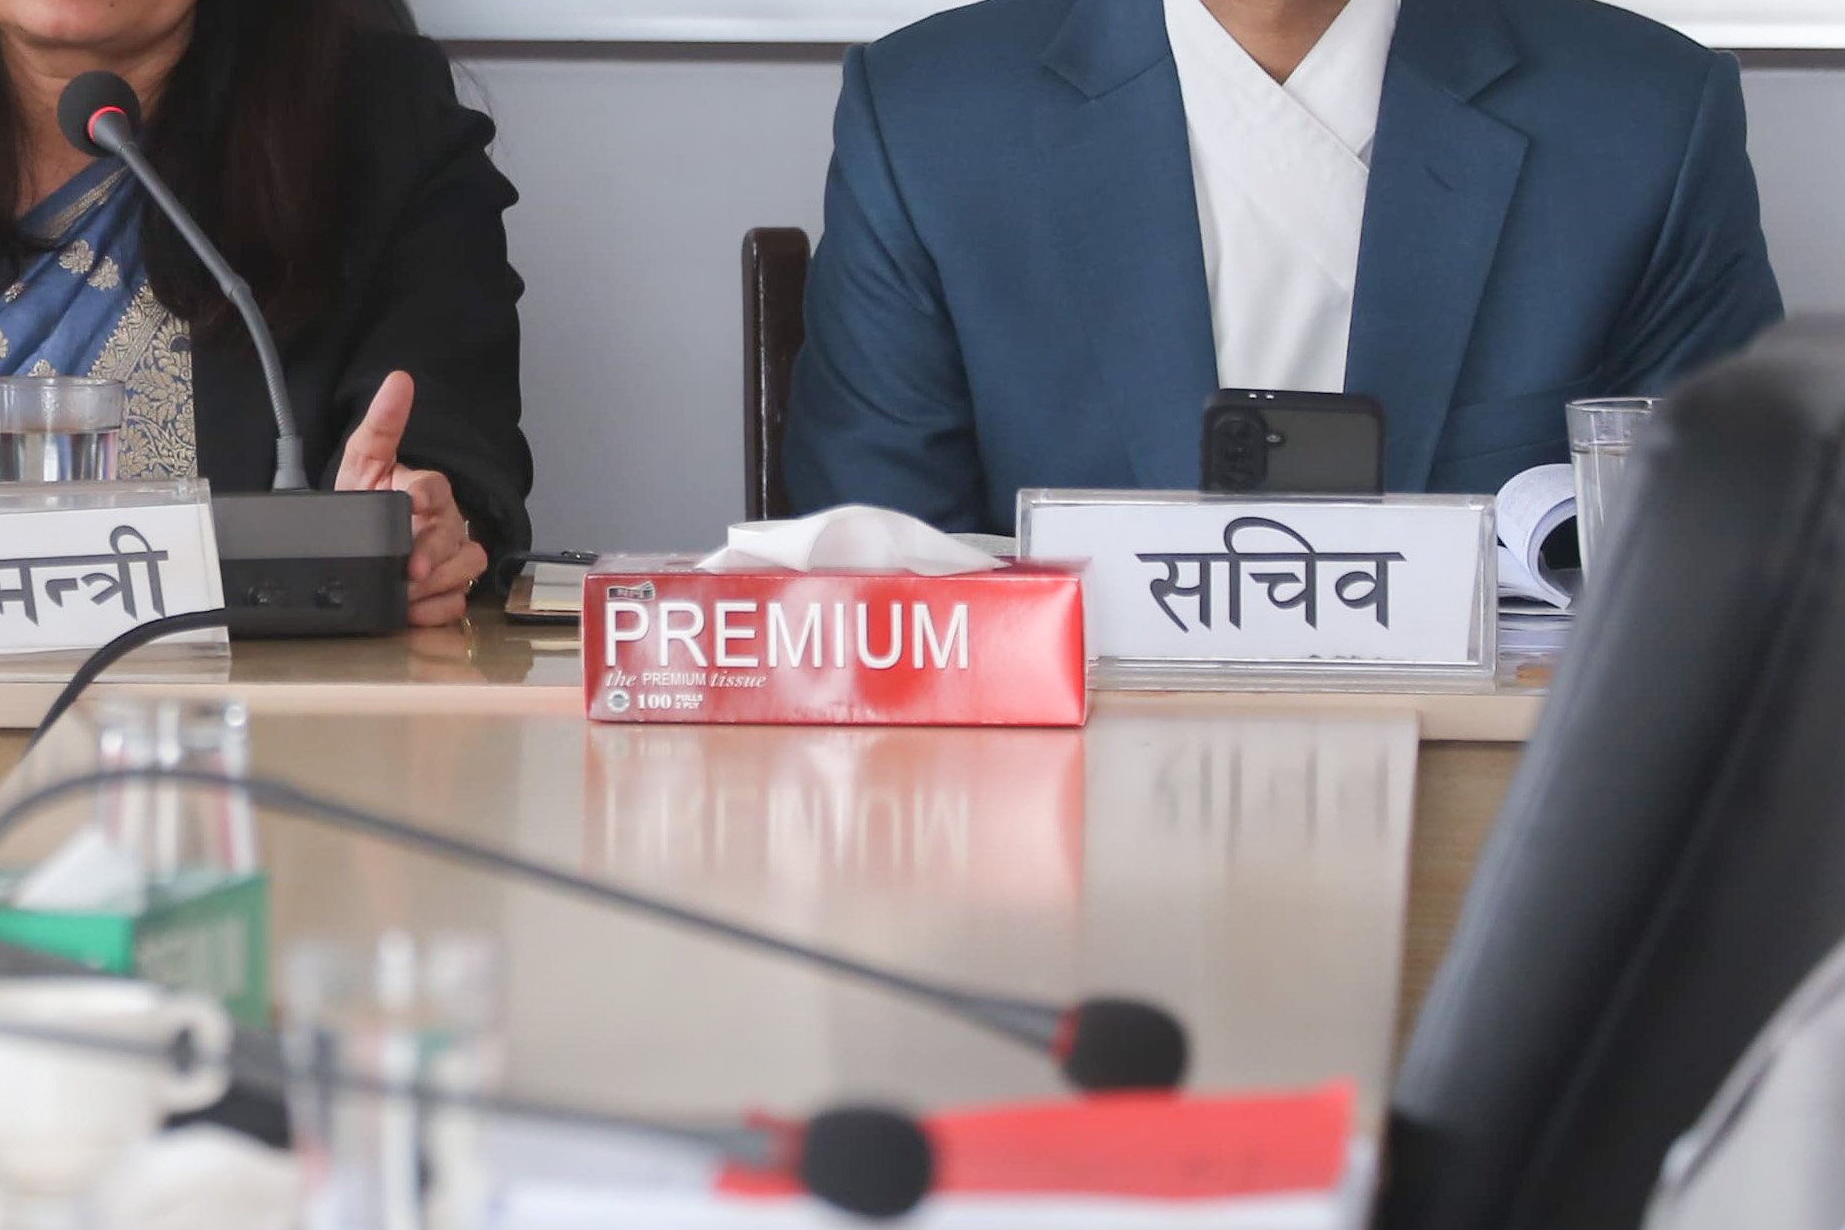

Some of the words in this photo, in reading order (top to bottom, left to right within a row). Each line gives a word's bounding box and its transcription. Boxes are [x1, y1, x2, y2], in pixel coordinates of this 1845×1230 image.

[1134, 516, 1405, 632] सचिव
[605, 601, 968, 669] PREMIUM
[605, 671, 637, 687] the
[643, 673, 706, 686] PREMIUM
[710, 672, 767, 687] tissue
[637, 694, 672, 709] 100
